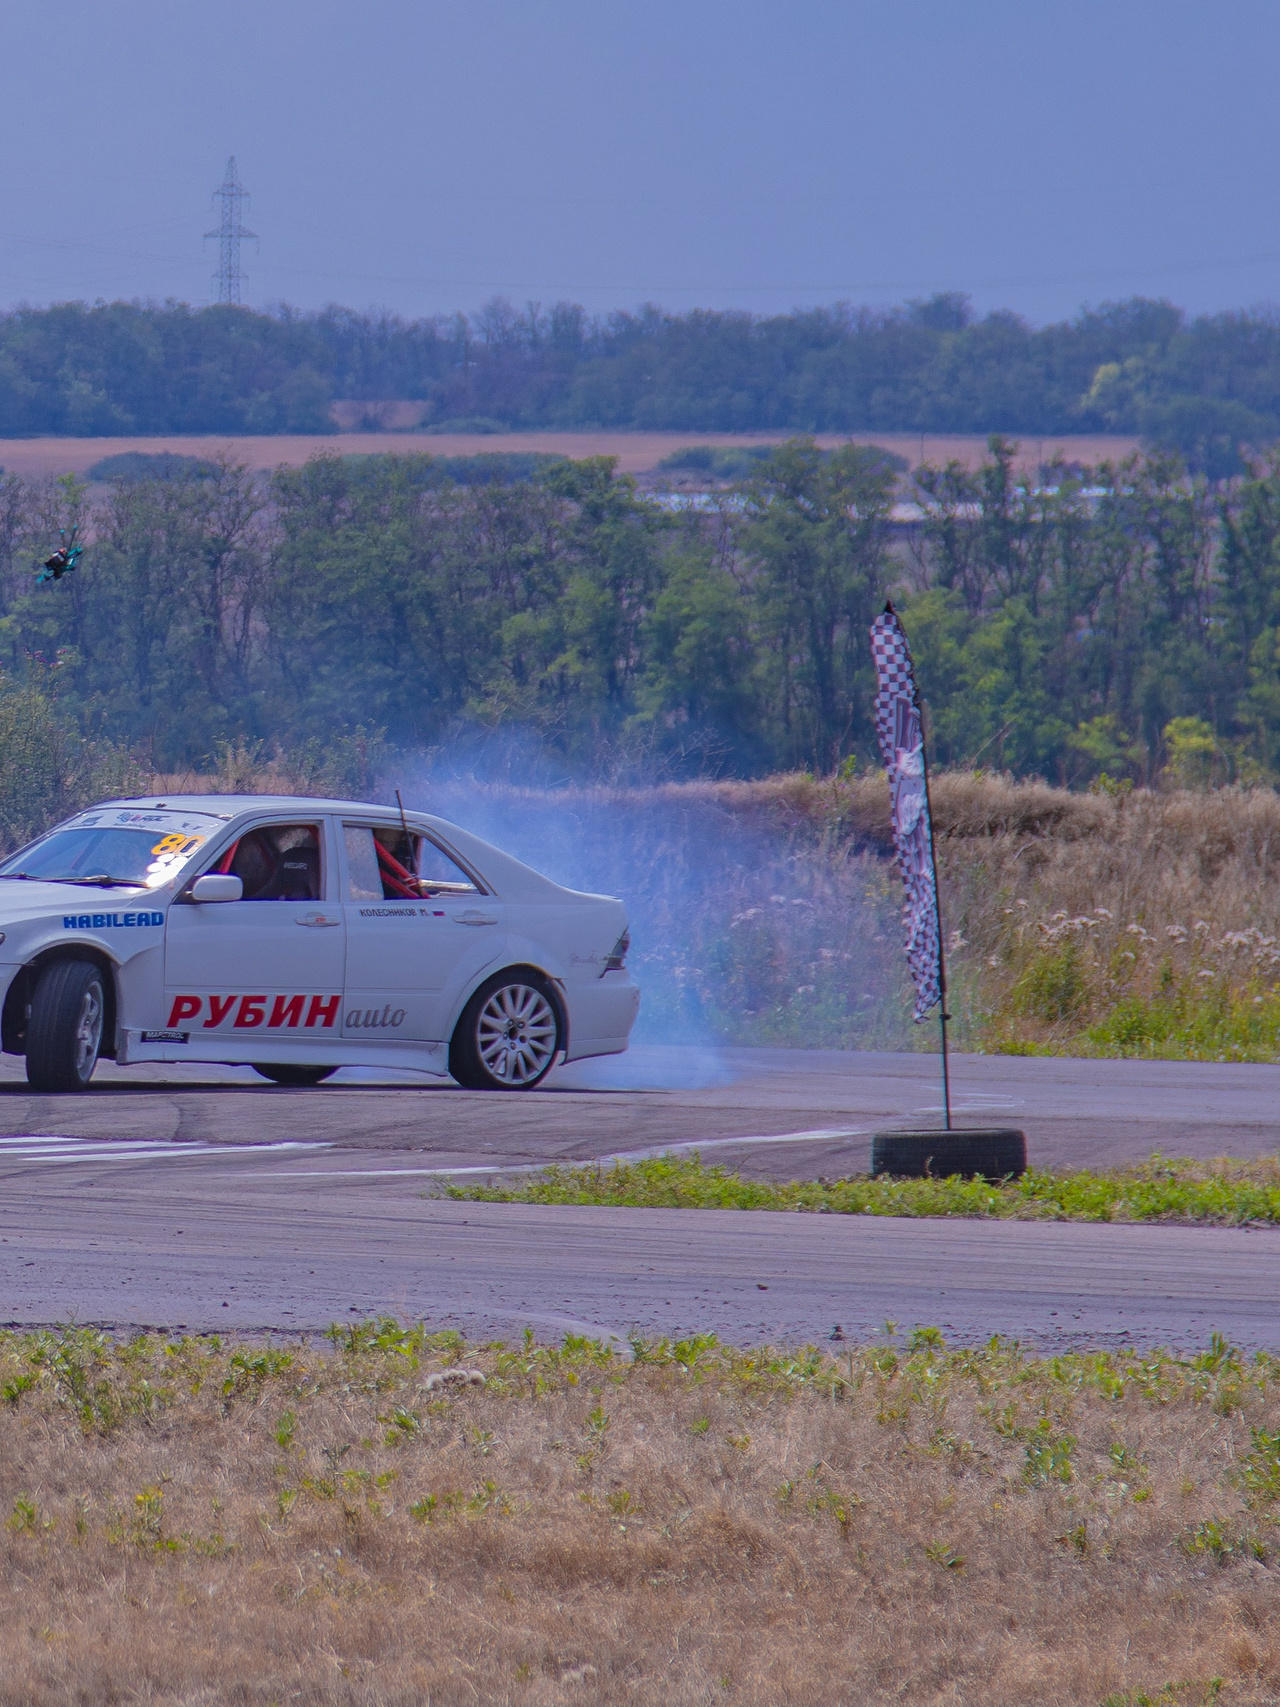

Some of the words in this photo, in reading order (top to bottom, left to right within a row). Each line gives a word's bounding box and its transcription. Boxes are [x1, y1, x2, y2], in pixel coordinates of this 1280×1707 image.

[151, 833, 208, 857] 80
[63, 911, 164, 929] HABILEAD
[360, 908, 417, 917] КОЛЕСНИКОВ
[166, 994, 342, 1029] РУБИН
[345, 1003, 408, 1029] auto
